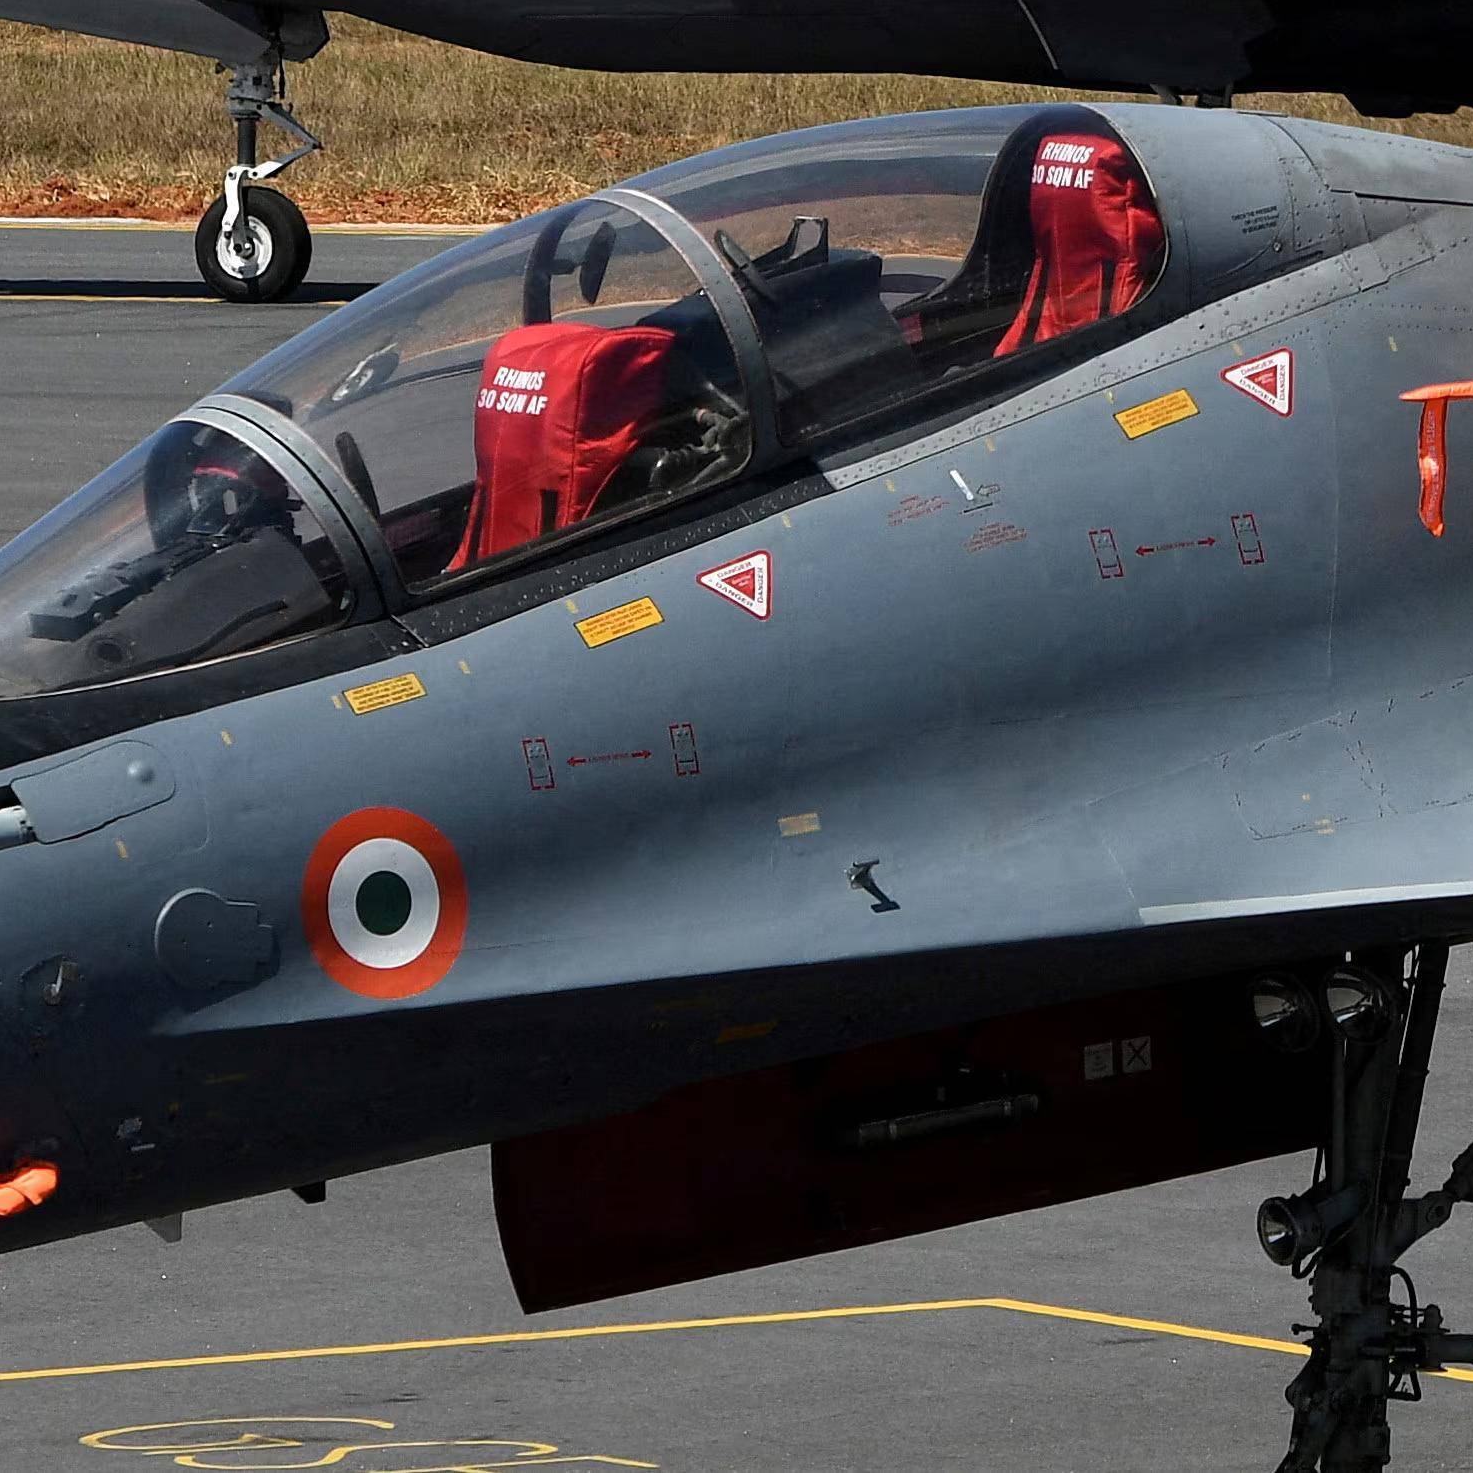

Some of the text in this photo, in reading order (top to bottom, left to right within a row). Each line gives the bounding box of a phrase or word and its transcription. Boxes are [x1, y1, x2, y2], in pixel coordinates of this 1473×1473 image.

[1041, 142, 1095, 164] RHINOS
[1046, 166, 1073, 188] SQN
[1074, 168, 1094, 189] AF
[493, 366, 546, 391] RHINOS
[478, 388, 548, 415] 30 SQN AF
[716, 582, 753, 607] DANGER
